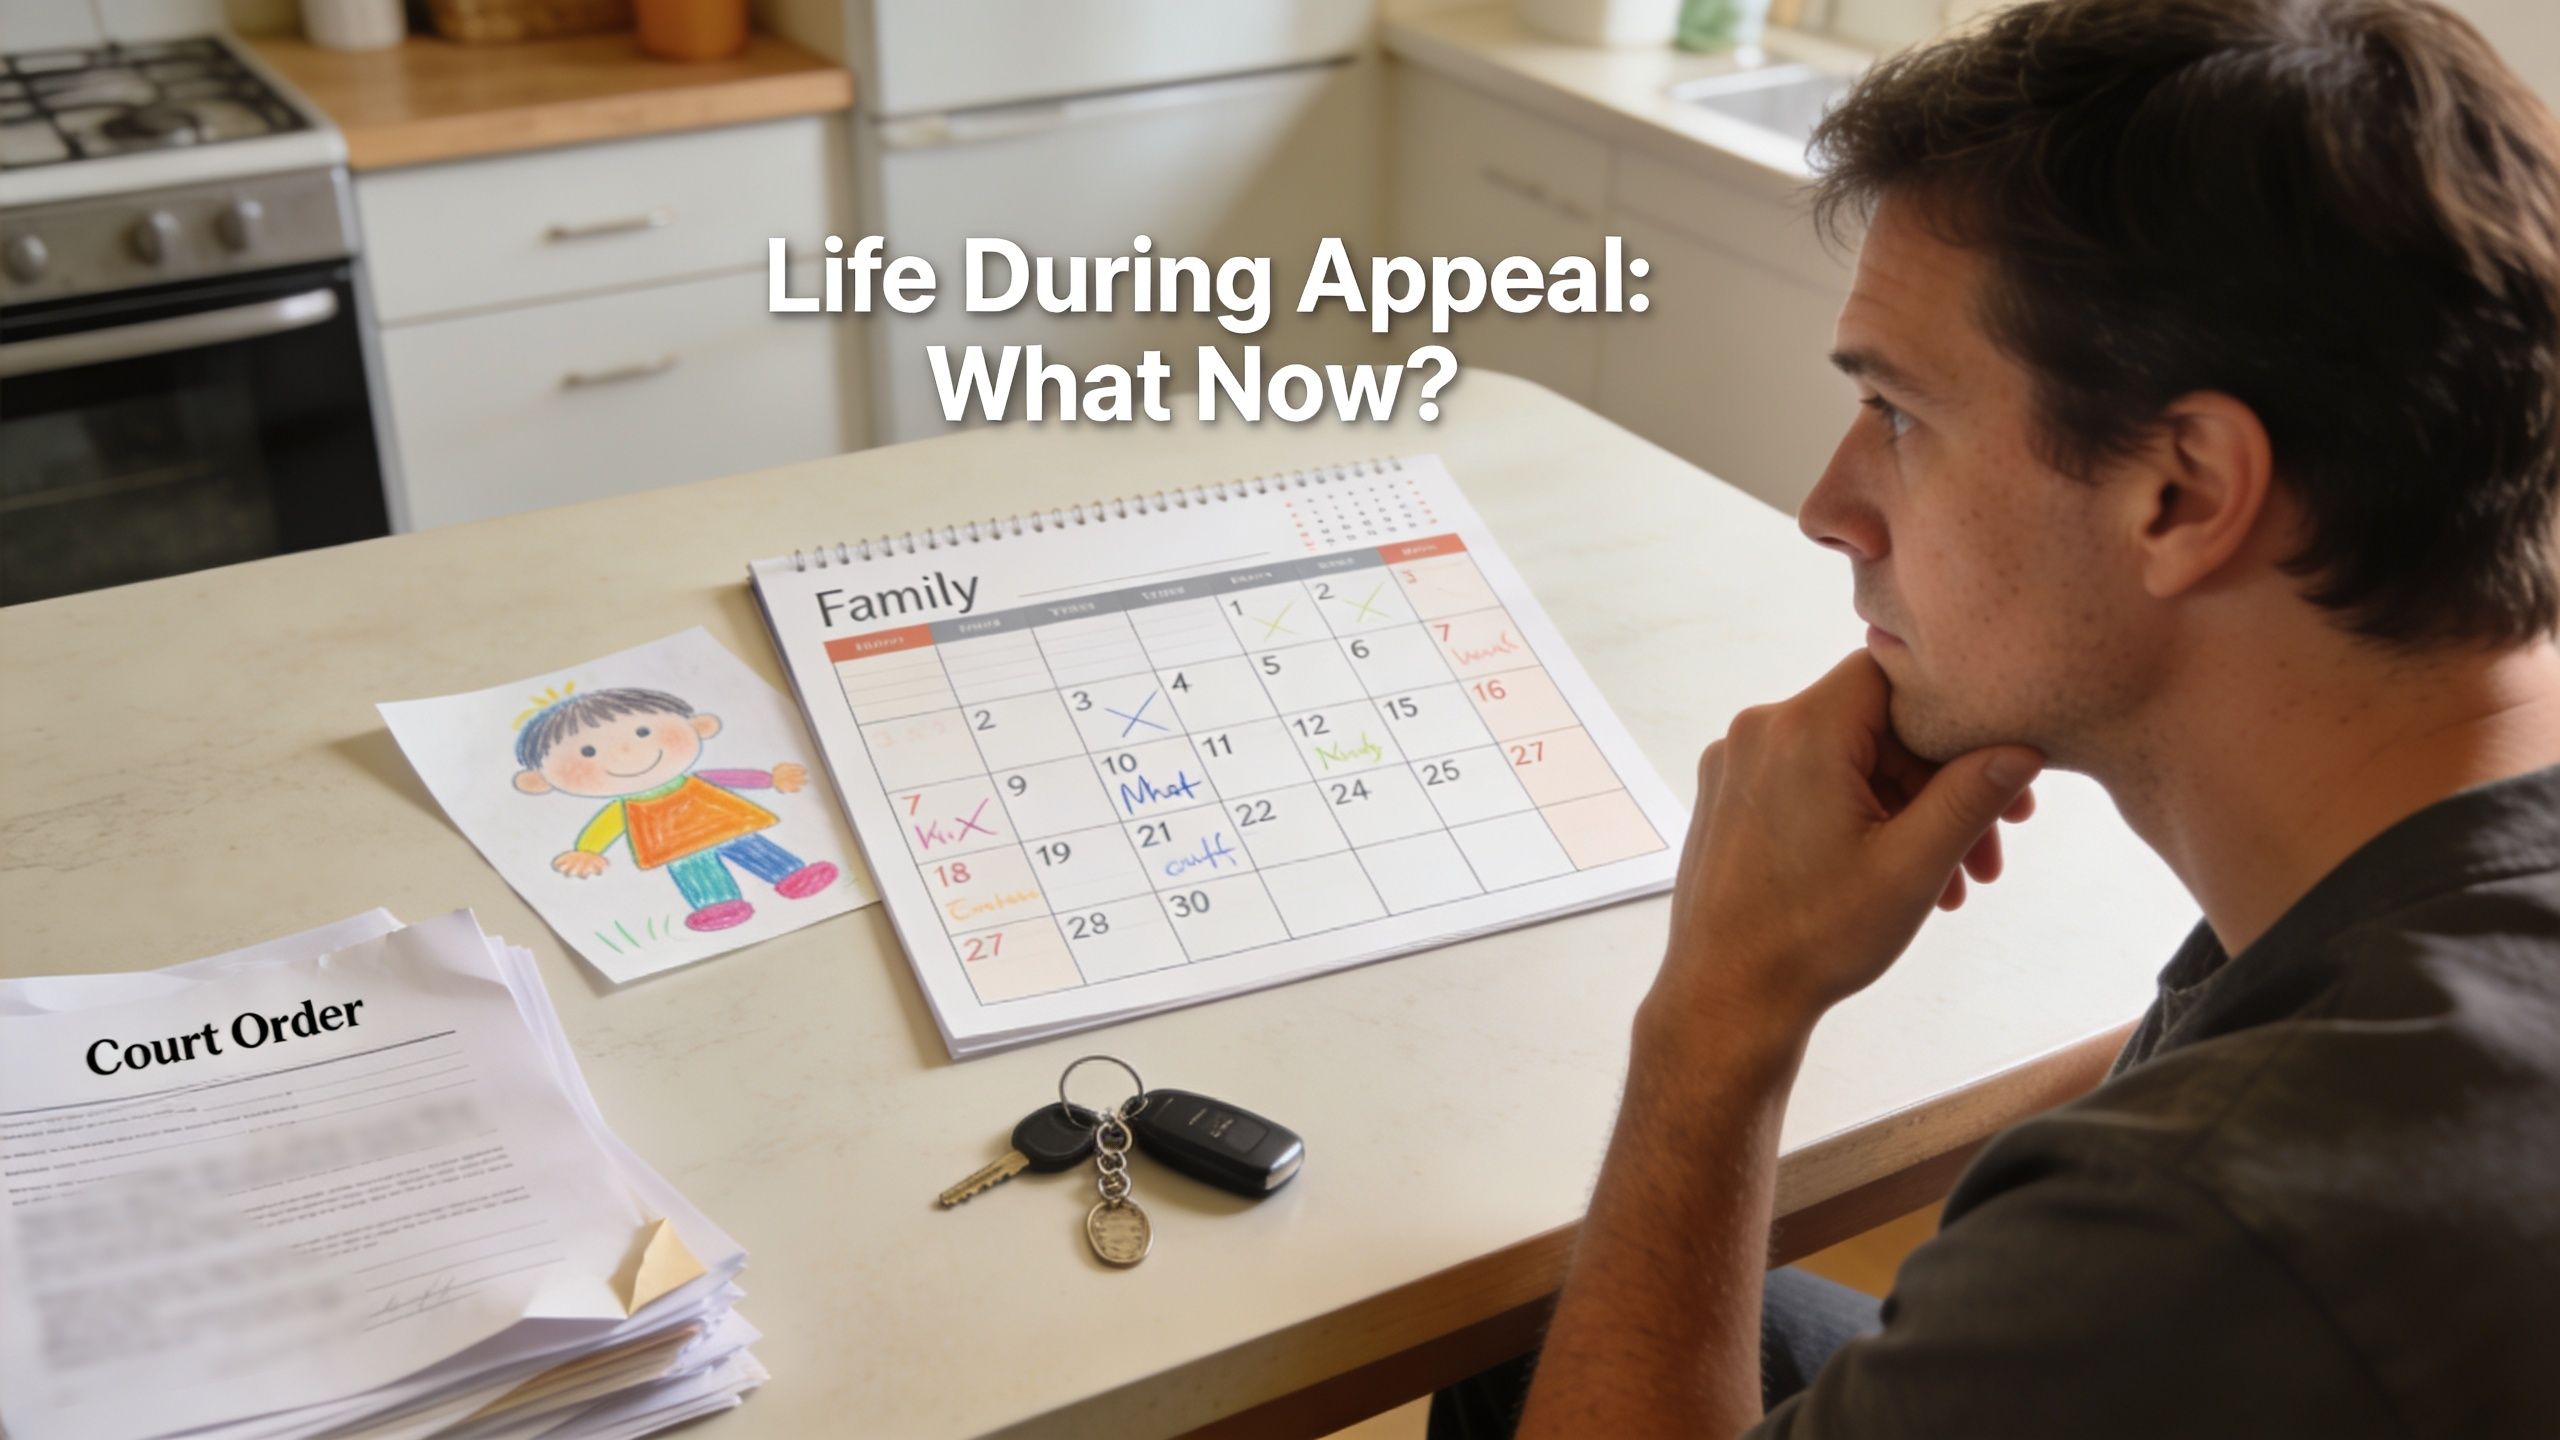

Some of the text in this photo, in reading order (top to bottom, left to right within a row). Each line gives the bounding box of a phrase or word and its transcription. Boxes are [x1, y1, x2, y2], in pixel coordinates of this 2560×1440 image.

[814, 571, 979, 628] Family
[1315, 583, 1334, 600] 2
[1230, 600, 1244, 617] 1
[1434, 624, 1451, 643] 7
[1350, 639, 1370, 659] 6
[1262, 656, 1281, 676] 5
[1171, 672, 1192, 694] 4
[1473, 680, 1506, 702] 16
[1071, 691, 1093, 712] 3
[1384, 697, 1418, 720] 15
[974, 710, 996, 731] 2
[1293, 715, 1330, 737] 12
[1202, 734, 1233, 758] 11
[1510, 741, 1545, 766] 27
[1101, 753, 1137, 775] 10
[1422, 760, 1460, 786] 25
[1007, 775, 1027, 797] 9
[1331, 779, 1371, 805] 24
[902, 794, 921, 816] 7
[1235, 799, 1277, 827] 22
[1137, 821, 1172, 848] 21
[1036, 841, 1071, 867] 19
[934, 862, 971, 888] 18
[1169, 890, 1211, 918] 30
[1067, 913, 1110, 941] 28
[964, 933, 1003, 962] 27
[86, 999, 364, 1076] Court Order
